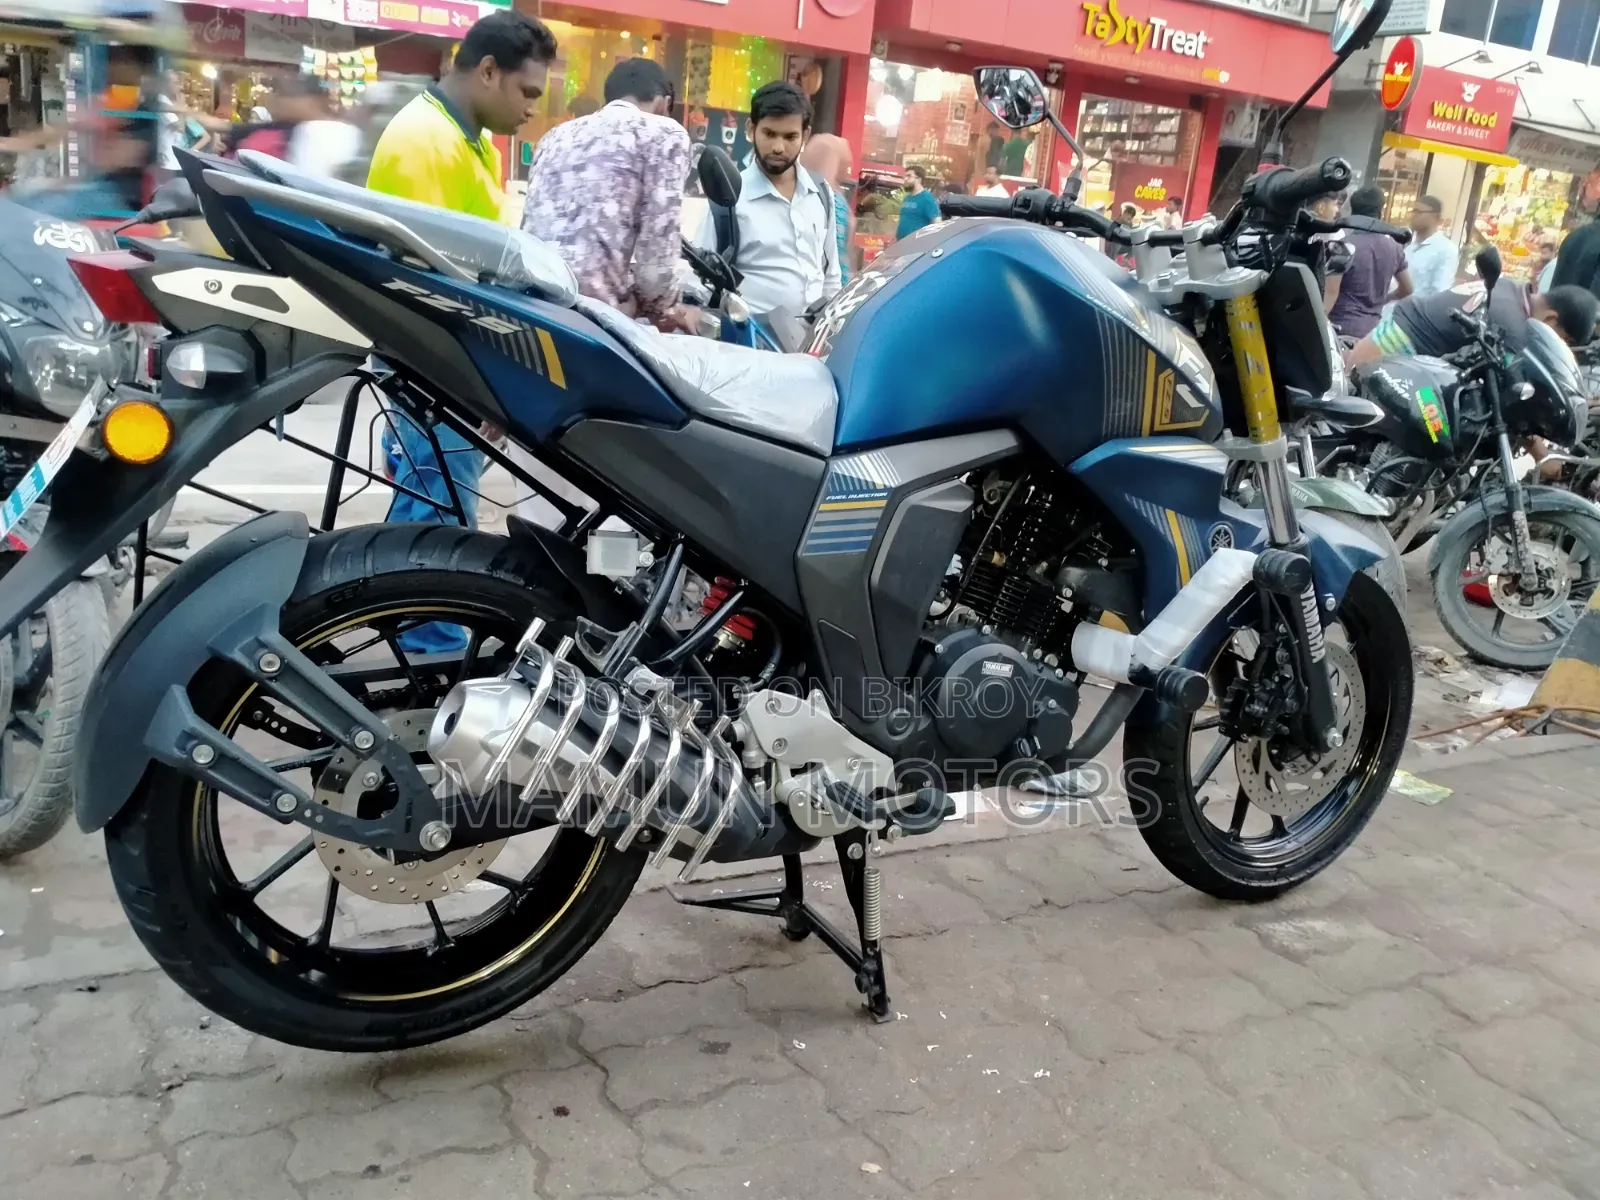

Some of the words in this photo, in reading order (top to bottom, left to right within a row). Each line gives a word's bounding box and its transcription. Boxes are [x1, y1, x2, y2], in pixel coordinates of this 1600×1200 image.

[1431, 100, 1463, 121] Well
[1464, 108, 1498, 128] Food
[1426, 119, 1456, 133] BAKERY
[1464, 126, 1490, 139] SWEET
[1134, 184, 1167, 201] CAKES
[847, 491, 888, 499] INJECTION
[1301, 578, 1326, 663] YAMAHA
